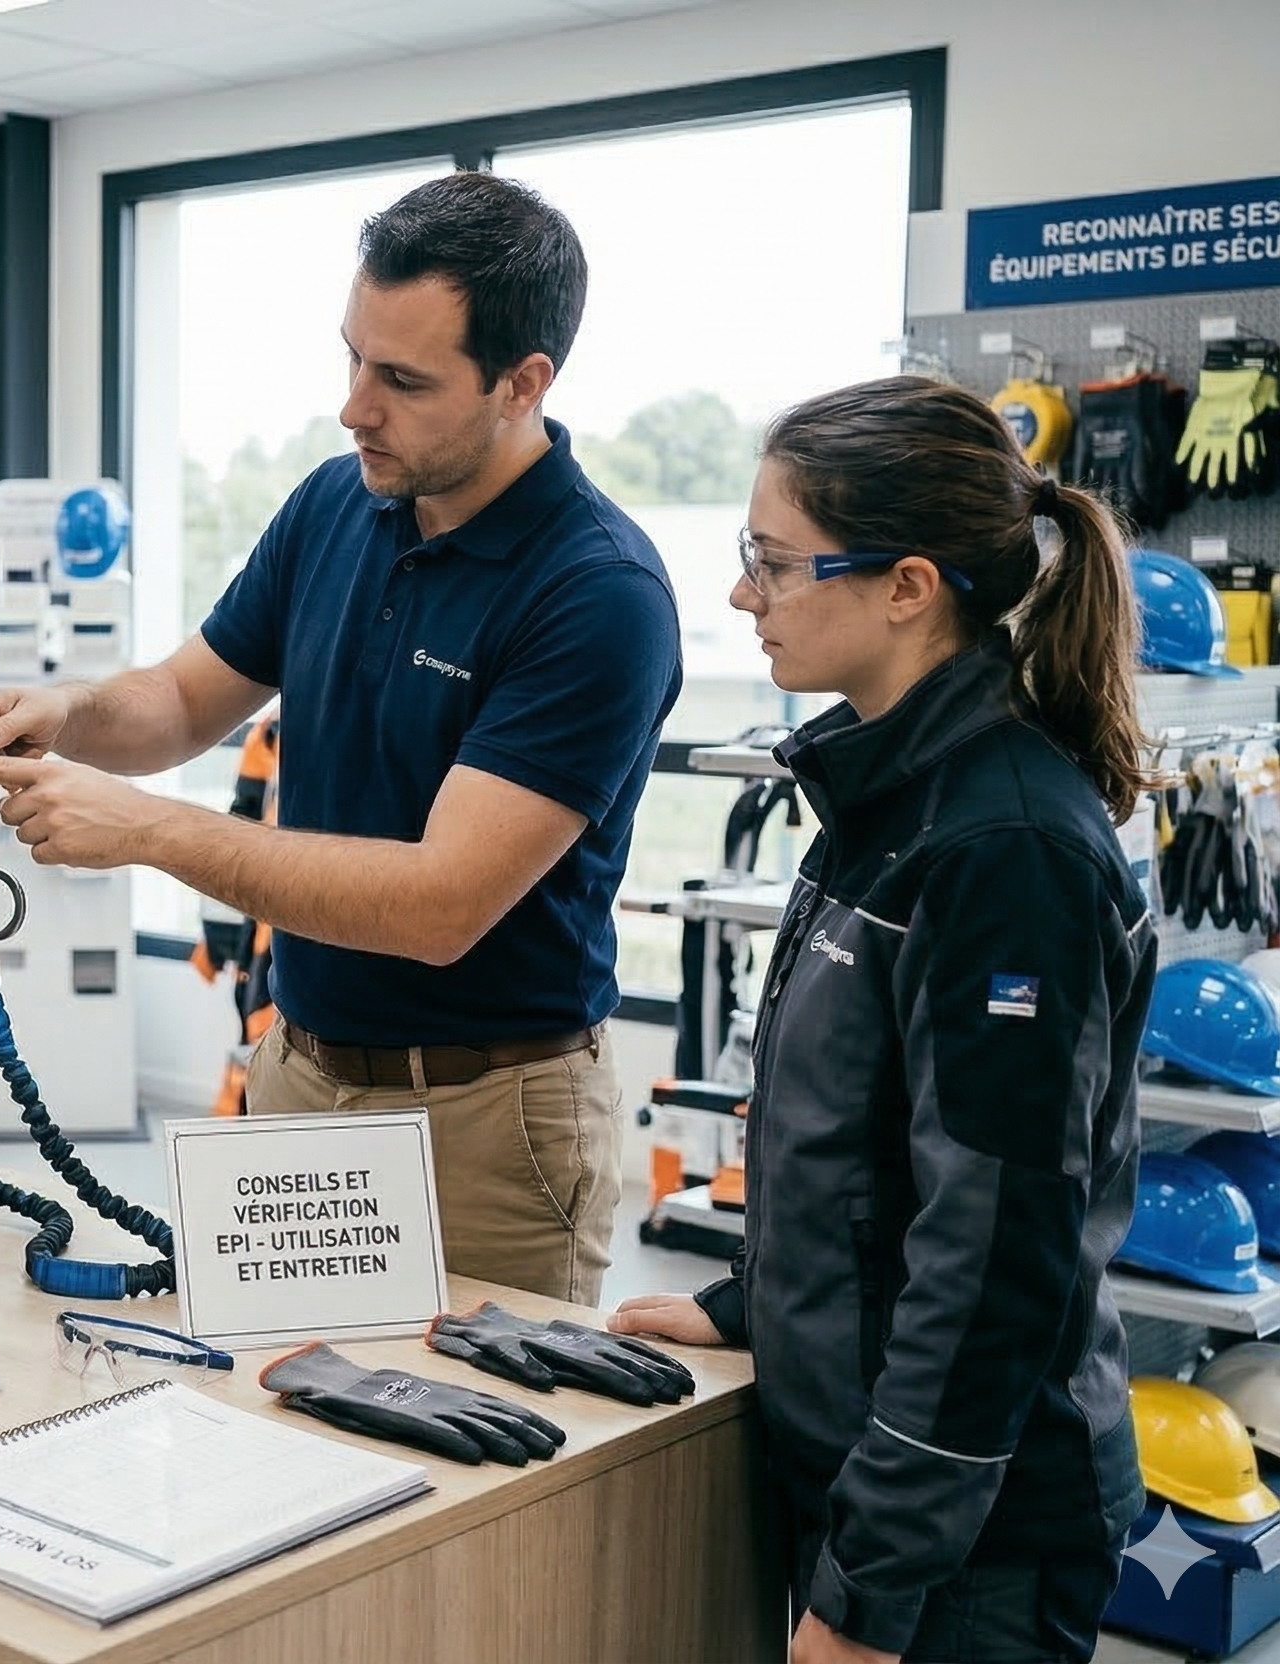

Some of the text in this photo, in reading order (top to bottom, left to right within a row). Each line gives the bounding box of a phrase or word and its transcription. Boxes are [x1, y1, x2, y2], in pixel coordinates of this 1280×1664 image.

[1042, 200, 1280, 247] RECONNAÎTRE SES
[989, 245, 1166, 283] ÉQUIPEMENTS
[1171, 241, 1208, 268] DE
[237, 1170, 371, 1196] CONSEILS ET
[233, 1197, 379, 1224] VÉRIFICATION
[216, 1233, 250, 1254] EPI
[271, 1224, 400, 1251] UTILISATION
[238, 1253, 387, 1281] ET ENTRETIEN
